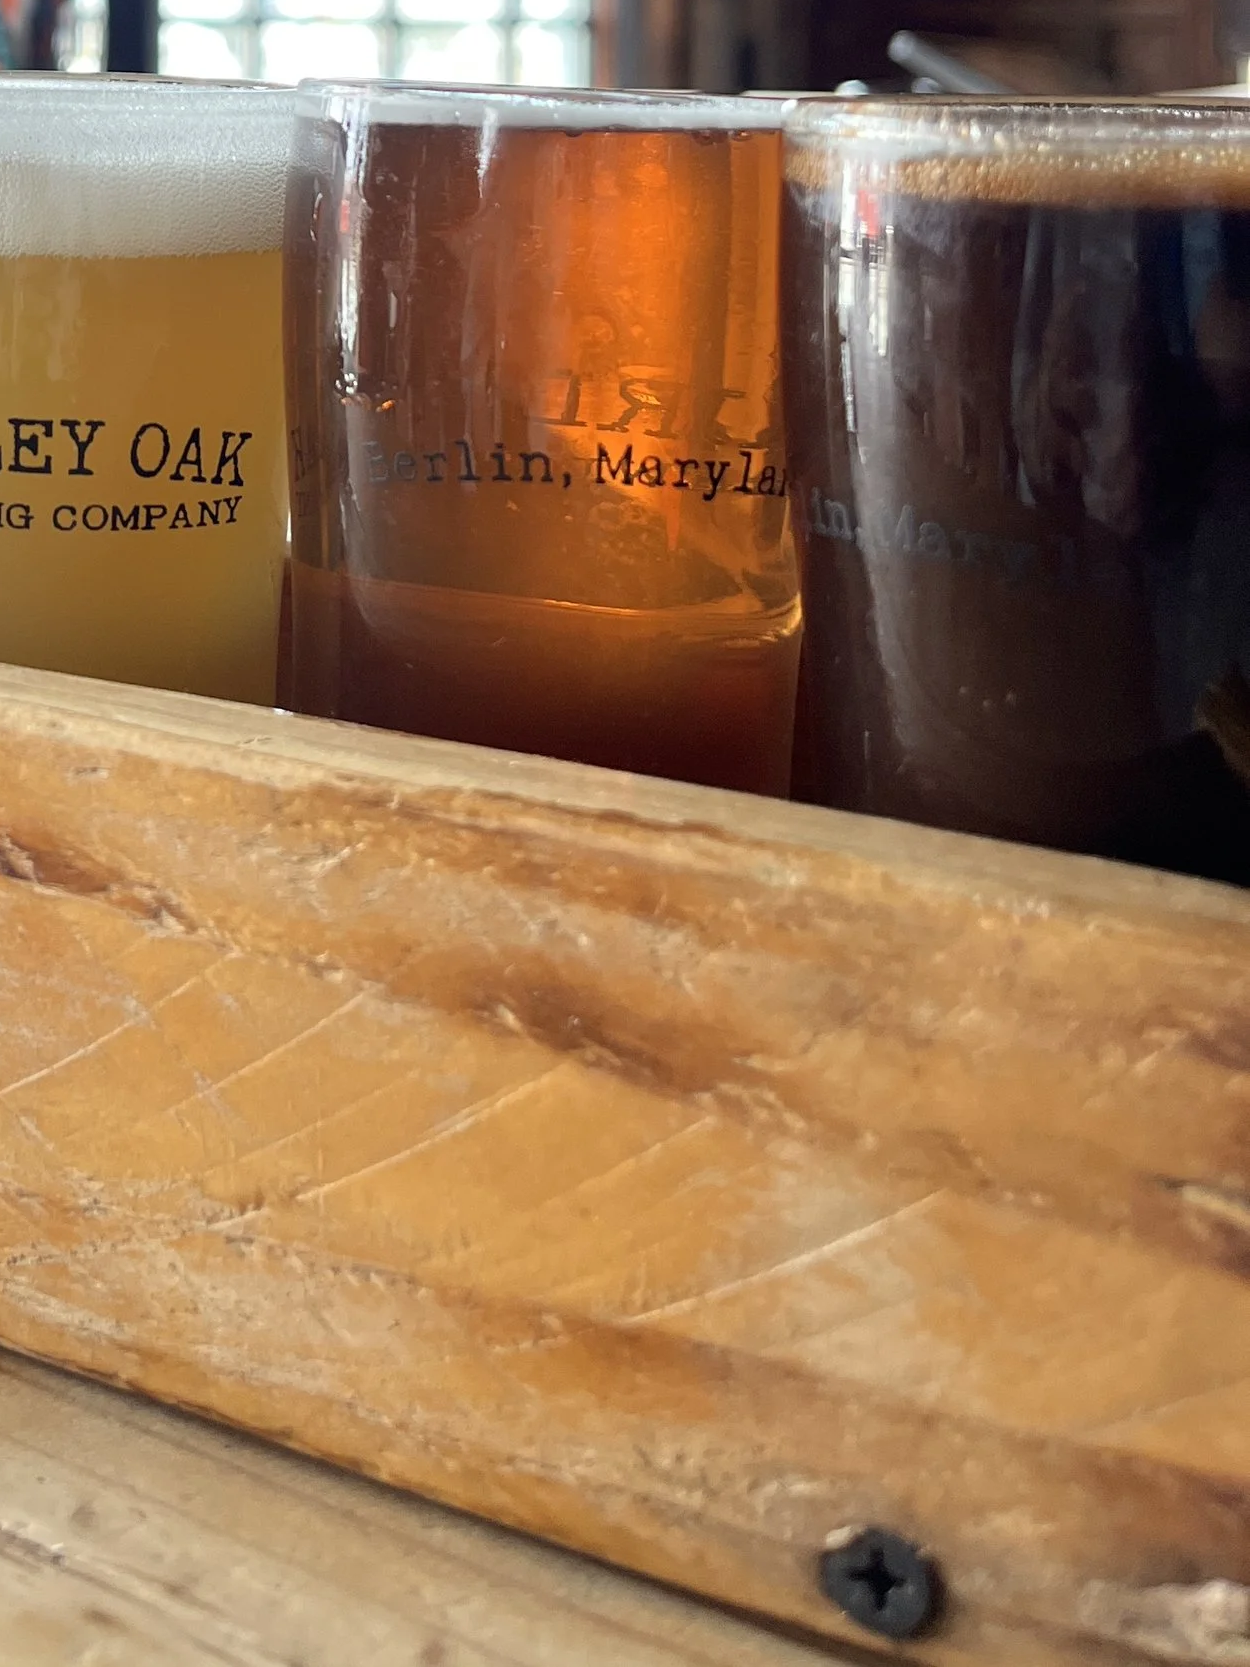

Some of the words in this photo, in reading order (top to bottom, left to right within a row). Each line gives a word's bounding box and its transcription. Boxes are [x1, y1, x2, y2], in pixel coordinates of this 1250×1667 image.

[130, 422, 252, 487] OAK
[364, 438, 573, 489] Berlin,
[52, 495, 243, 531] COMPANY
